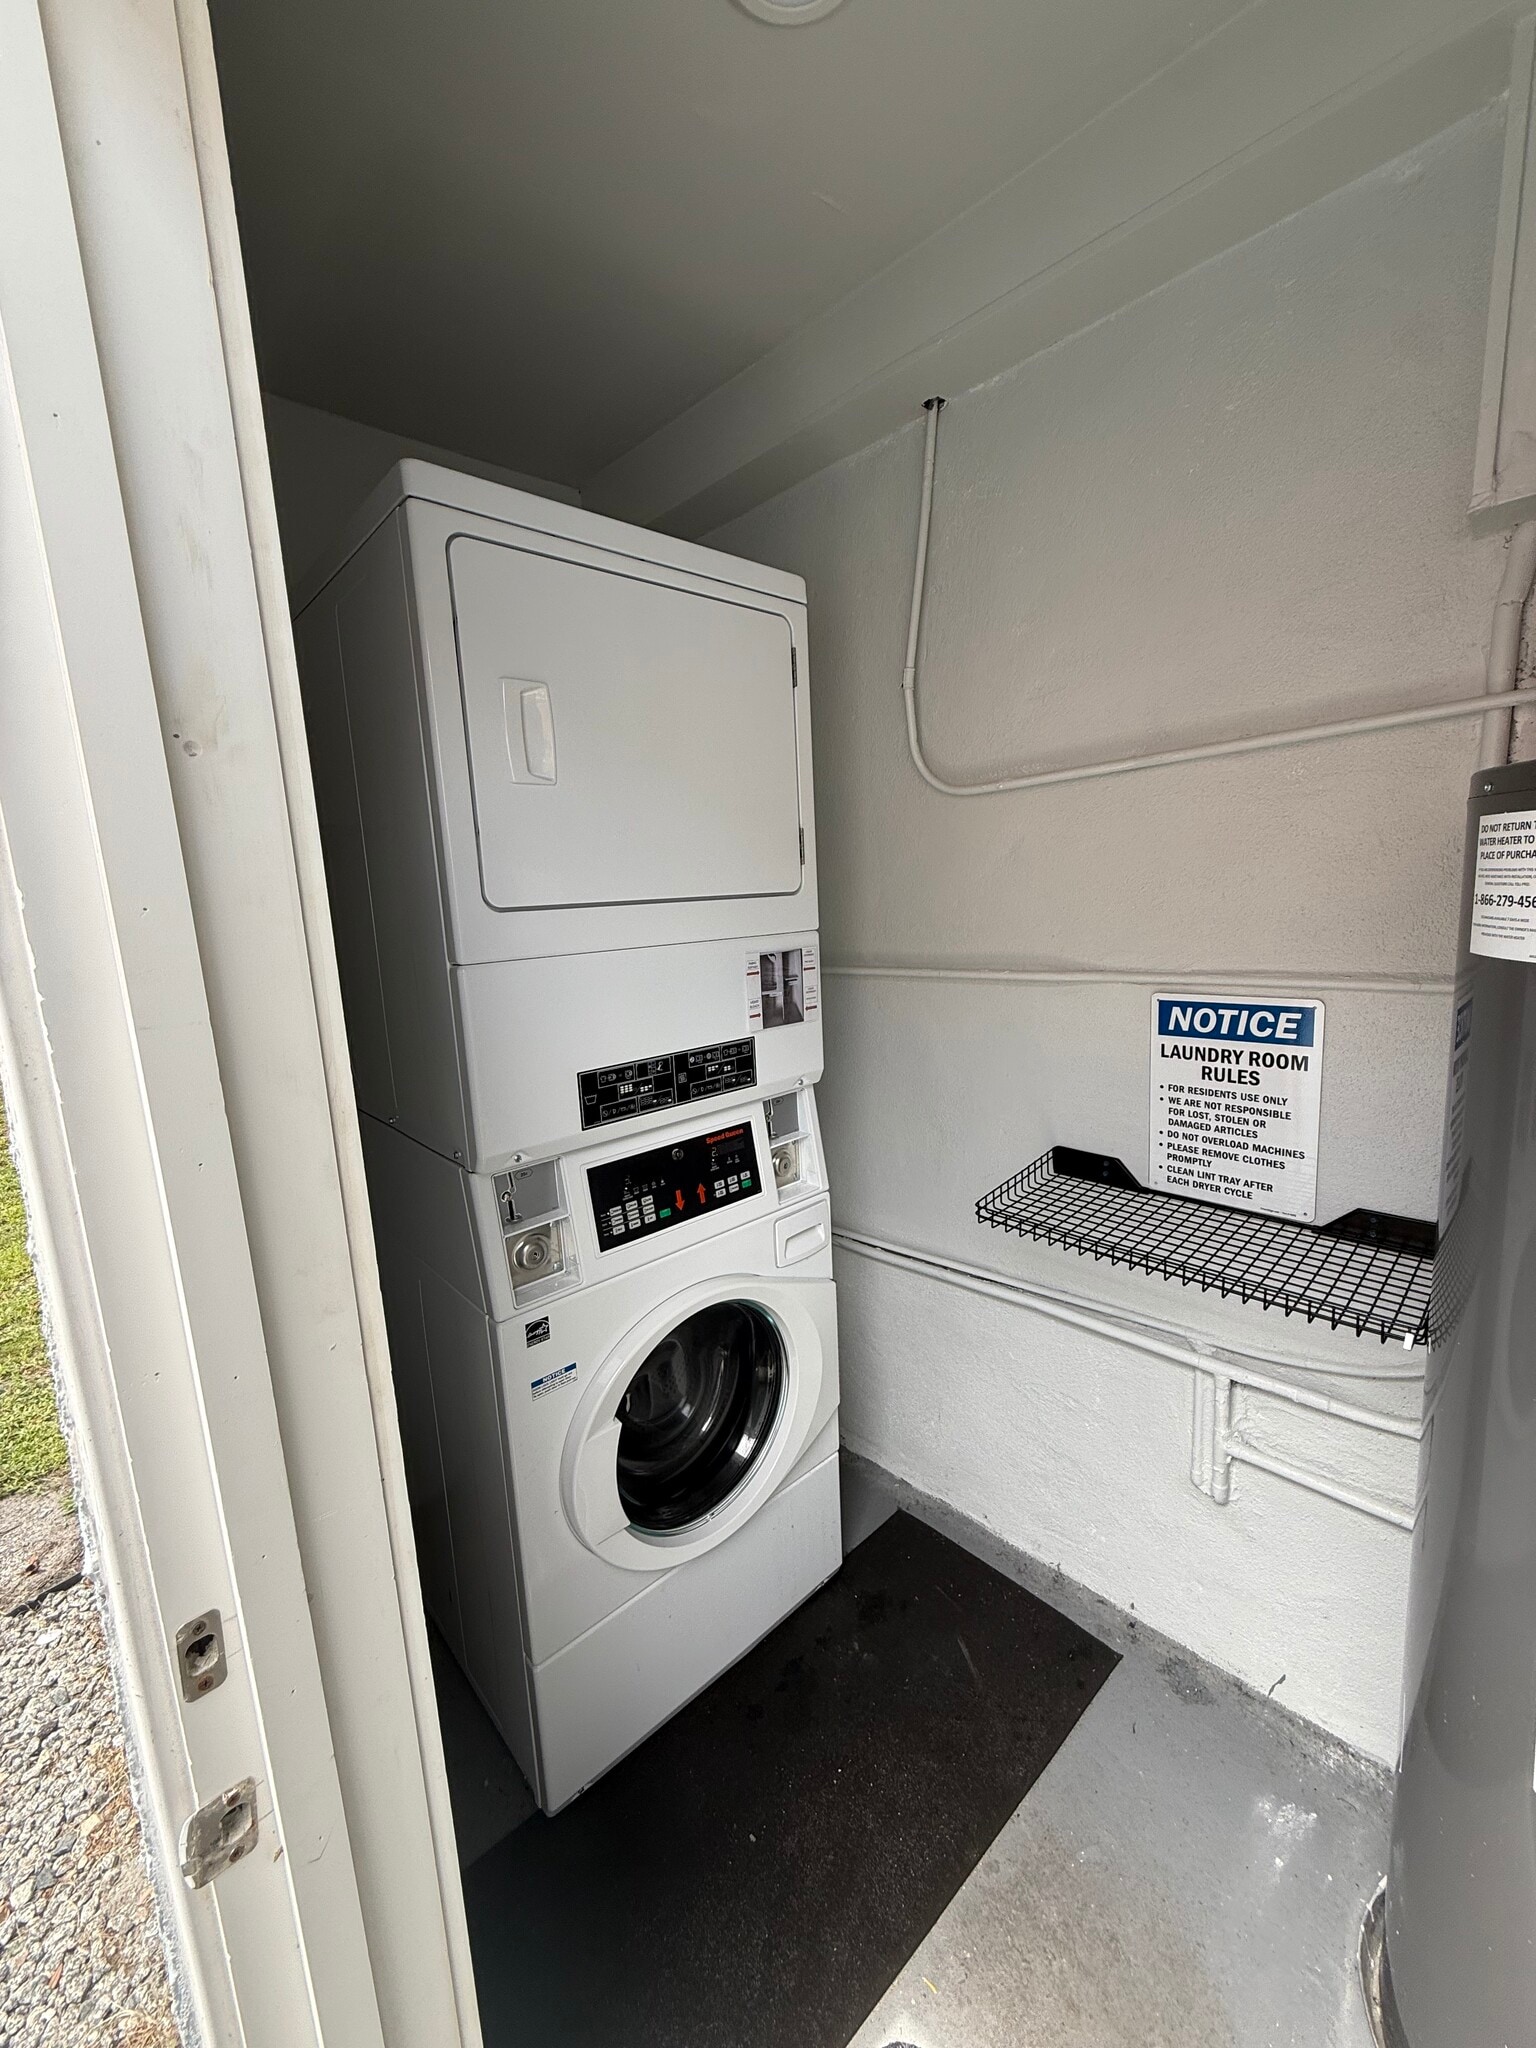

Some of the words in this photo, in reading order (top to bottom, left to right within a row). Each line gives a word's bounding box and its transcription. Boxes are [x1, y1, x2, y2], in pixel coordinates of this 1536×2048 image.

[1481, 824, 1489, 833] DO
[1490, 823, 1502, 833] NOT
[1503, 821, 1532, 831] RETURN
[1497, 835, 1522, 846] HEATER
[1524, 835, 1535, 844] TO
[1480, 851, 1495, 860] PLACE
[1497, 851, 1505, 859] OF
[1168, 1006, 1302, 1040] NOTICE
[1160, 1043, 1244, 1065] LAUNDRY
[1249, 1051, 1309, 1072] ROOM
[1201, 1065, 1260, 1086] RULES
[1168, 1084, 1185, 1093] FOR
[1188, 1086, 1237, 1100] RESIDENTS
[1240, 1093, 1260, 1103] USE
[1263, 1096, 1288, 1106] ONLY
[1168, 1096, 1181, 1105] WE
[1184, 1099, 1201, 1108] ARE
[1204, 1101, 1222, 1111] NOT
[1224, 1104, 1292, 1120] RESPONSIBLE
[1168, 1107, 1185, 1117] FOR
[1188, 1110, 1211, 1121] LOST,
[1214, 1114, 1249, 1126] STOLEN
[1252, 1119, 1267, 1128] OR
[706, 1133, 725, 1144] Speed
[725, 1128, 744, 1138] Queen
[1168, 1118, 1211, 1131] DAMAGED
[1214, 1125, 1258, 1139] ARTICLES
[1167, 1130, 1179, 1139] DO
[1182, 1132, 1199, 1142] NOT
[1201, 1136, 1249, 1150] OVERLOAD
[1252, 1143, 1305, 1160] MACHINES
[1167, 1142, 1200, 1154] PLEASE
[1202, 1148, 1240, 1162] REMOVE
[1242, 1155, 1286, 1170] CLOTHES
[1167, 1152, 1212, 1168] PROMPTLY
[1167, 1165, 1194, 1177] CLEAN
[1197, 1170, 1216, 1181] LINT
[1218, 1174, 1241, 1186] TRAY
[1243, 1180, 1273, 1192] AFTER
[1167, 1175, 1190, 1187] EACH
[1192, 1180, 1221, 1193] DRYER
[1224, 1187, 1253, 1199] CYCLE
[542, 1368, 566, 1383] NOTICE
